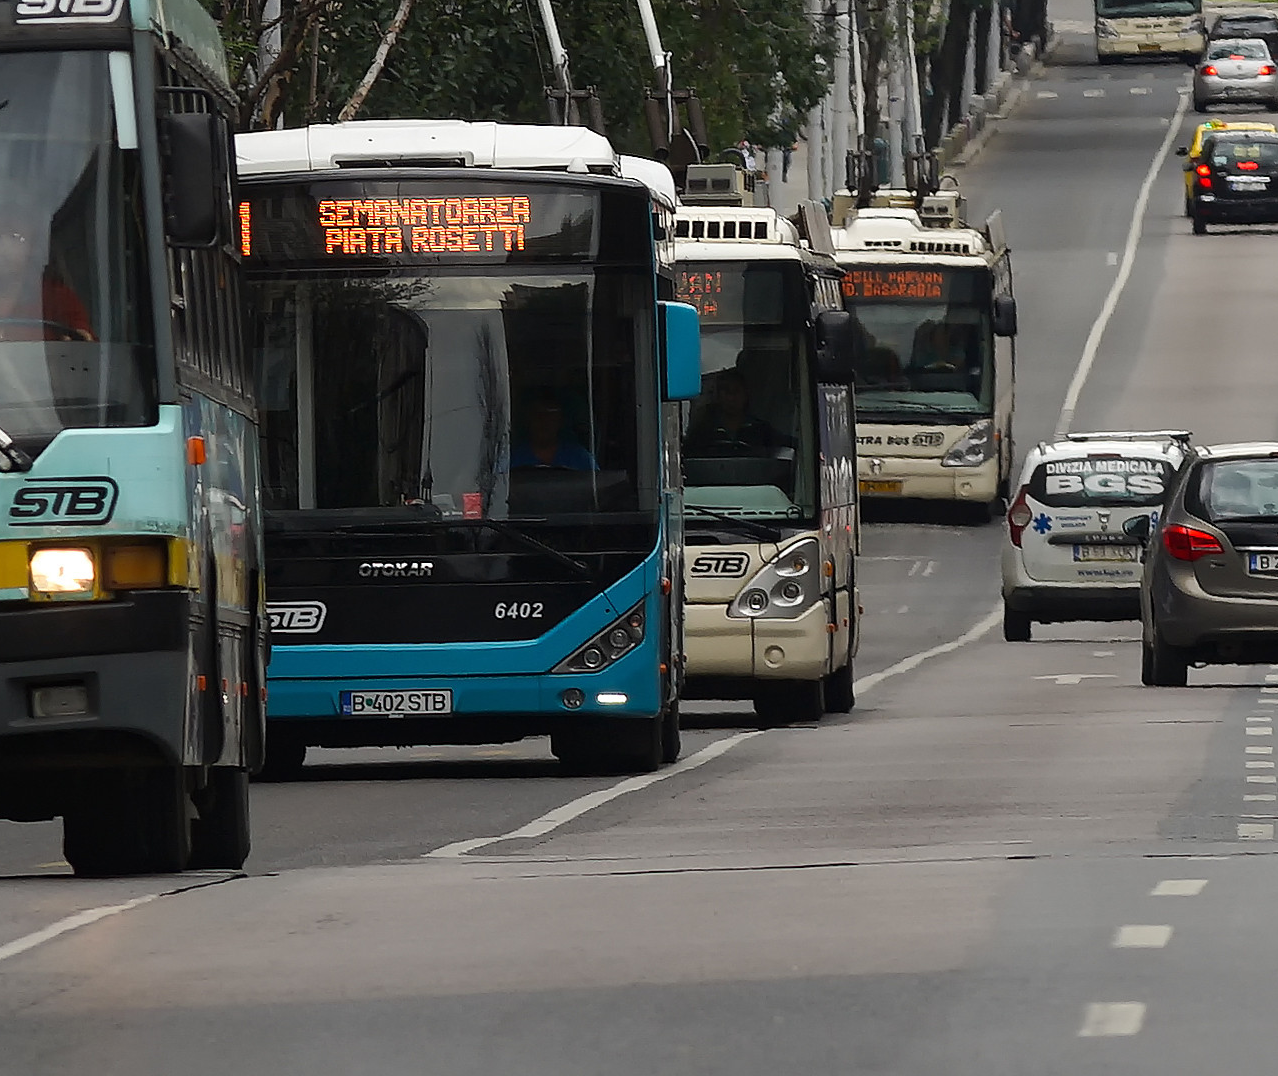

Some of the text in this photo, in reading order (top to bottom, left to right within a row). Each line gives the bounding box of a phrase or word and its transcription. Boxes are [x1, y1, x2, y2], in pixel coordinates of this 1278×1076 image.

[319, 196, 531, 227] SEMANATOAREA
[325, 223, 526, 254] PIATA ROSETTI
[1046, 459, 1165, 475] DIVIZIA MEDICALA
[1045, 474, 1165, 495] BGS
[8, 482, 111, 521] STB
[358, 562, 434, 577] OTOKAR
[690, 555, 746, 575] STB
[1260, 555, 1270, 570] B
[494, 601, 545, 620] 6402
[352, 694, 365, 713] B
[372, 693, 405, 712] 402
[408, 691, 447, 712] STB
